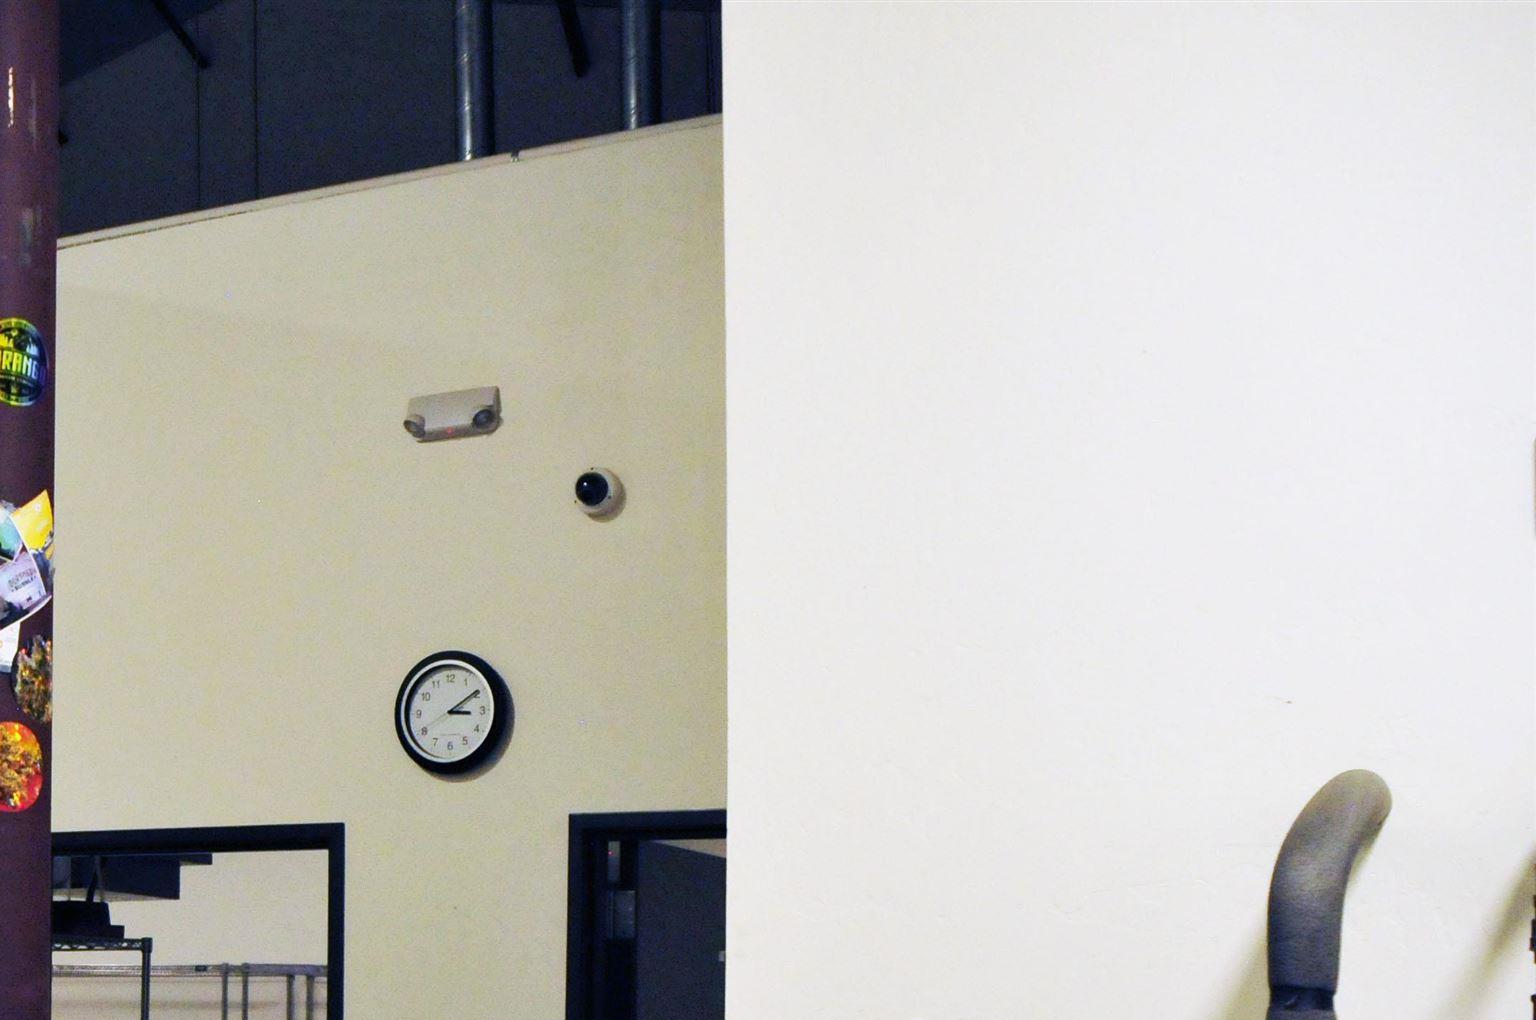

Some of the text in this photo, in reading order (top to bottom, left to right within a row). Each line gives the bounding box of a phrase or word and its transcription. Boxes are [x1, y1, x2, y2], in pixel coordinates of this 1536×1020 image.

[446, 674, 456, 683] 12
[432, 680, 440, 688] 11
[421, 692, 431, 701] 10
[416, 710, 422, 718] 9
[480, 706, 486, 715] 3
[421, 727, 427, 736] 8
[474, 724, 480, 733] 4
[432, 738, 438, 747] 7
[462, 736, 468, 746] 5
[447, 742, 453, 750] 6
